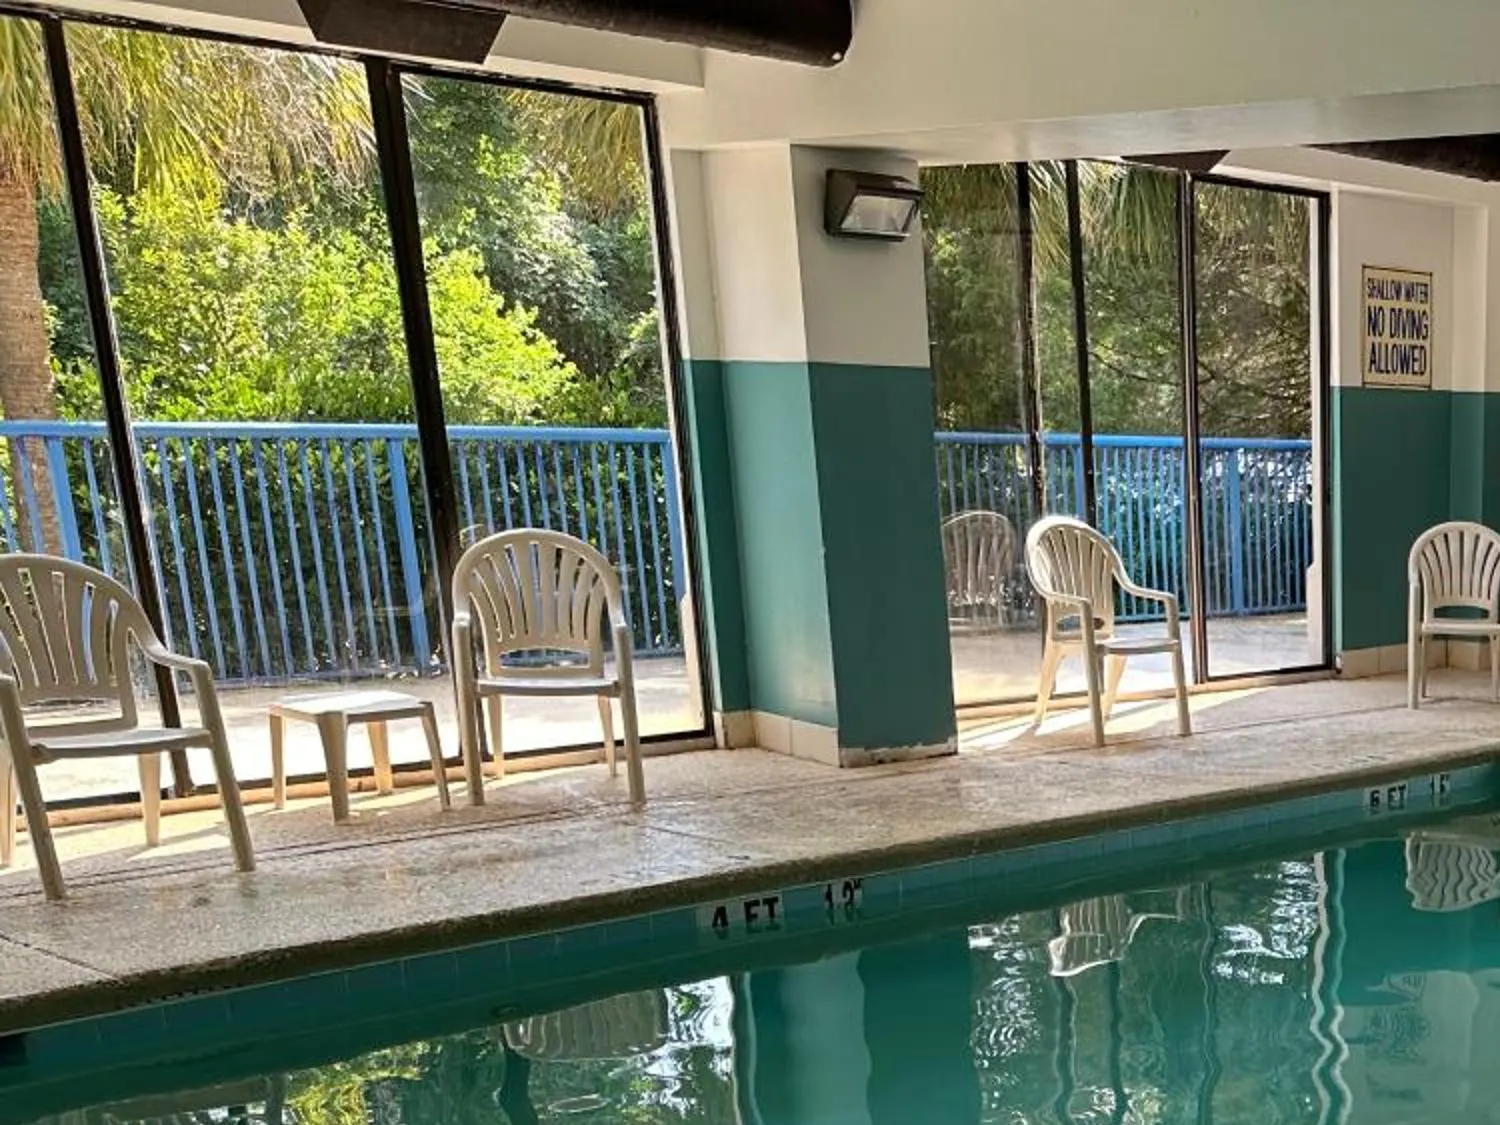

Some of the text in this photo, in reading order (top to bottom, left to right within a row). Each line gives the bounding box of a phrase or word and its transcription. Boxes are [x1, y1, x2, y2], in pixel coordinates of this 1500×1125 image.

[1367, 277, 1402, 301] SHALLOW
[1367, 305, 1429, 340] NO DIVING
[1368, 342, 1428, 375] ALLOWED
[711, 906, 730, 929] 4
[743, 895, 779, 926] FT
